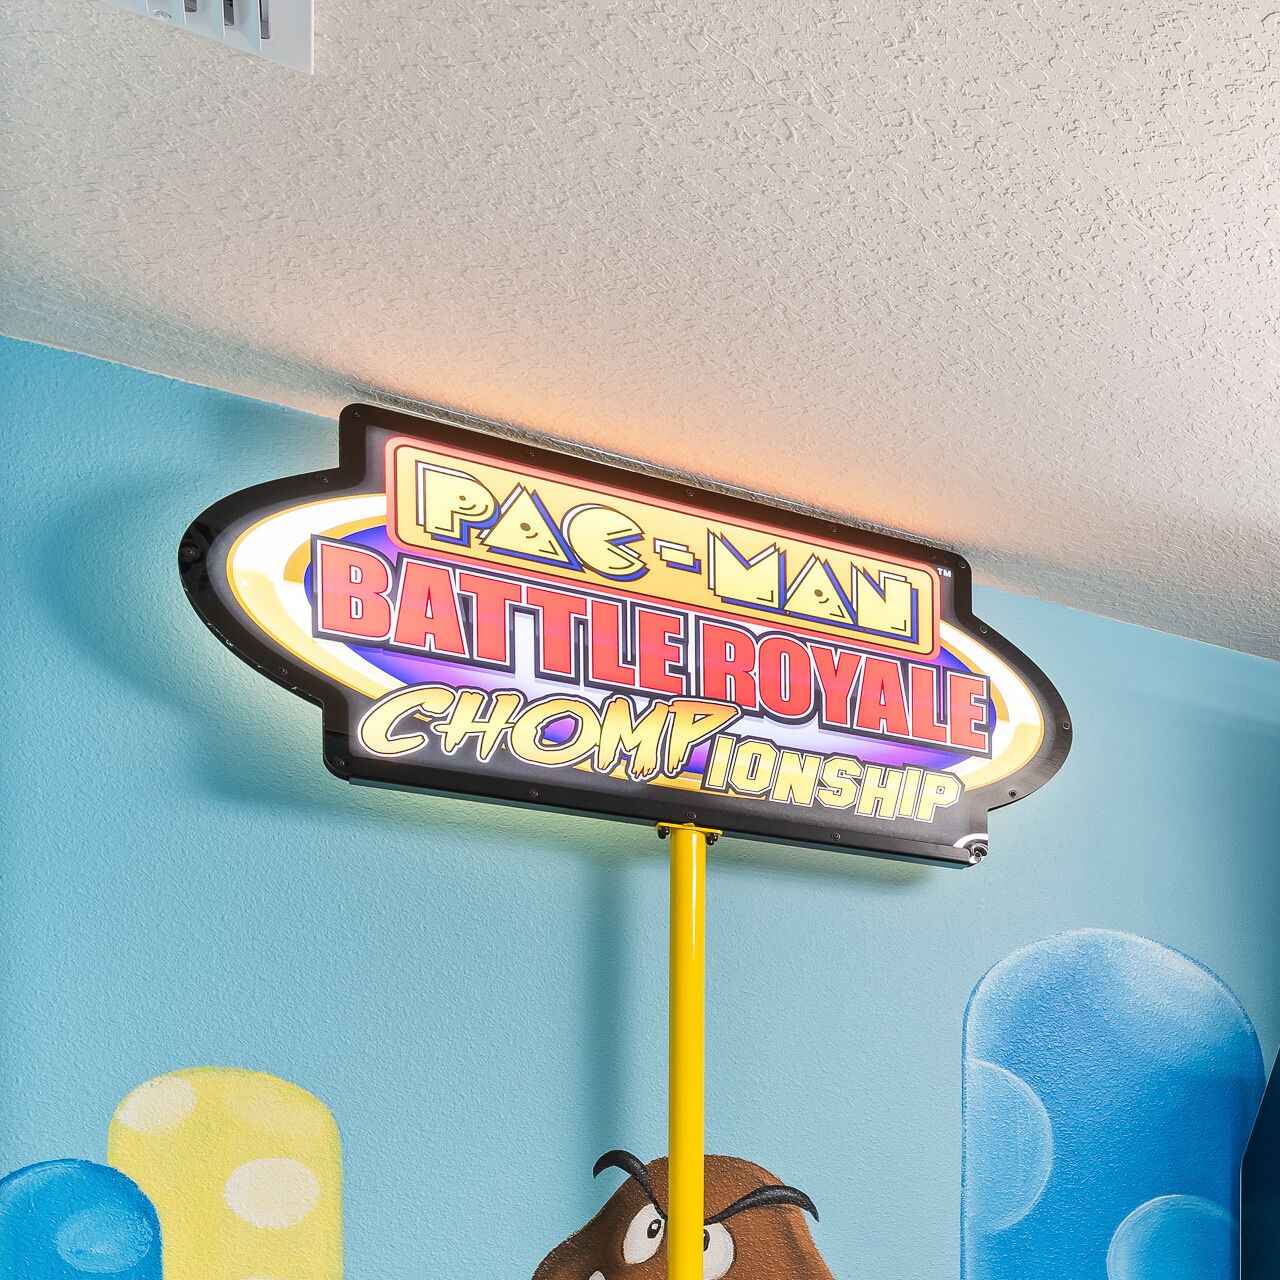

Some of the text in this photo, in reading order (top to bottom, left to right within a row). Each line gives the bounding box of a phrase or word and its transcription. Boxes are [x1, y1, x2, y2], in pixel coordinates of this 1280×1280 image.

[313, 535, 993, 756] BATTLE ROYALE
[415, 458, 919, 644] PAC-MAN
